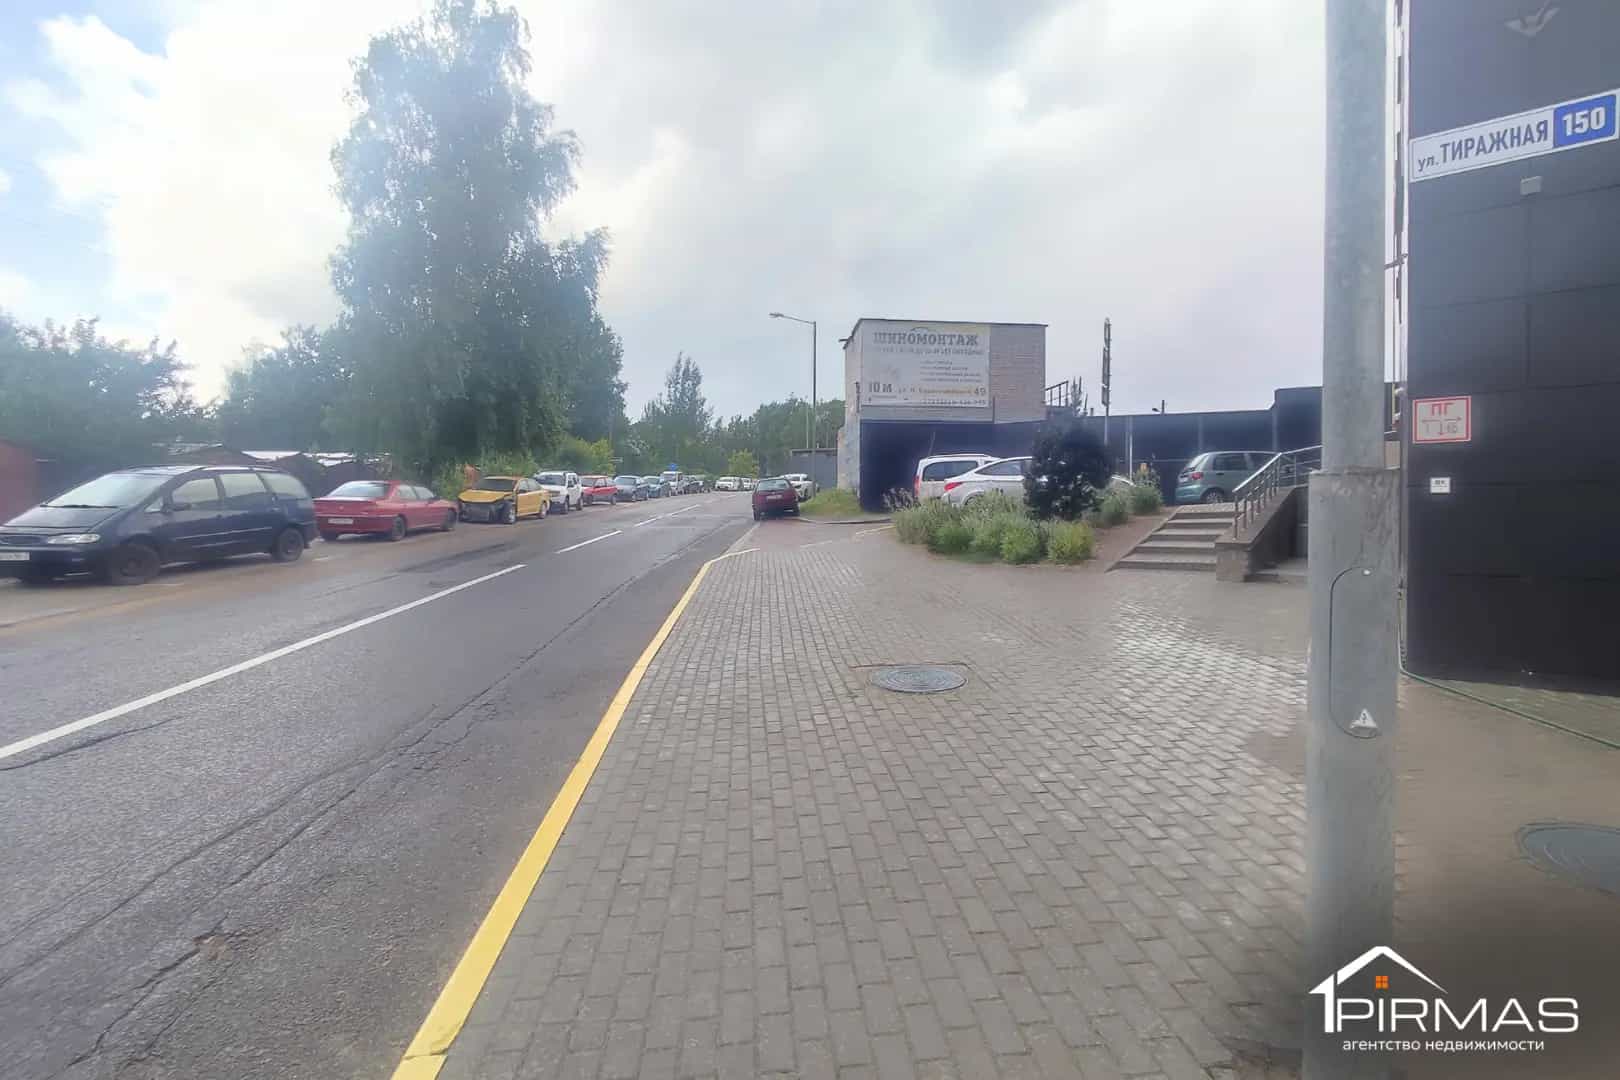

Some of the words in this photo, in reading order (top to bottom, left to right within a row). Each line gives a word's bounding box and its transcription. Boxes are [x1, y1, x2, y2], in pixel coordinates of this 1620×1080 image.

[1418, 155, 1439, 171] ул.
[1440, 119, 1549, 163] ТИРАЖНАЯ
[1562, 106, 1606, 137] 150
[873, 331, 979, 346] ШИНОМОНТАЖ
